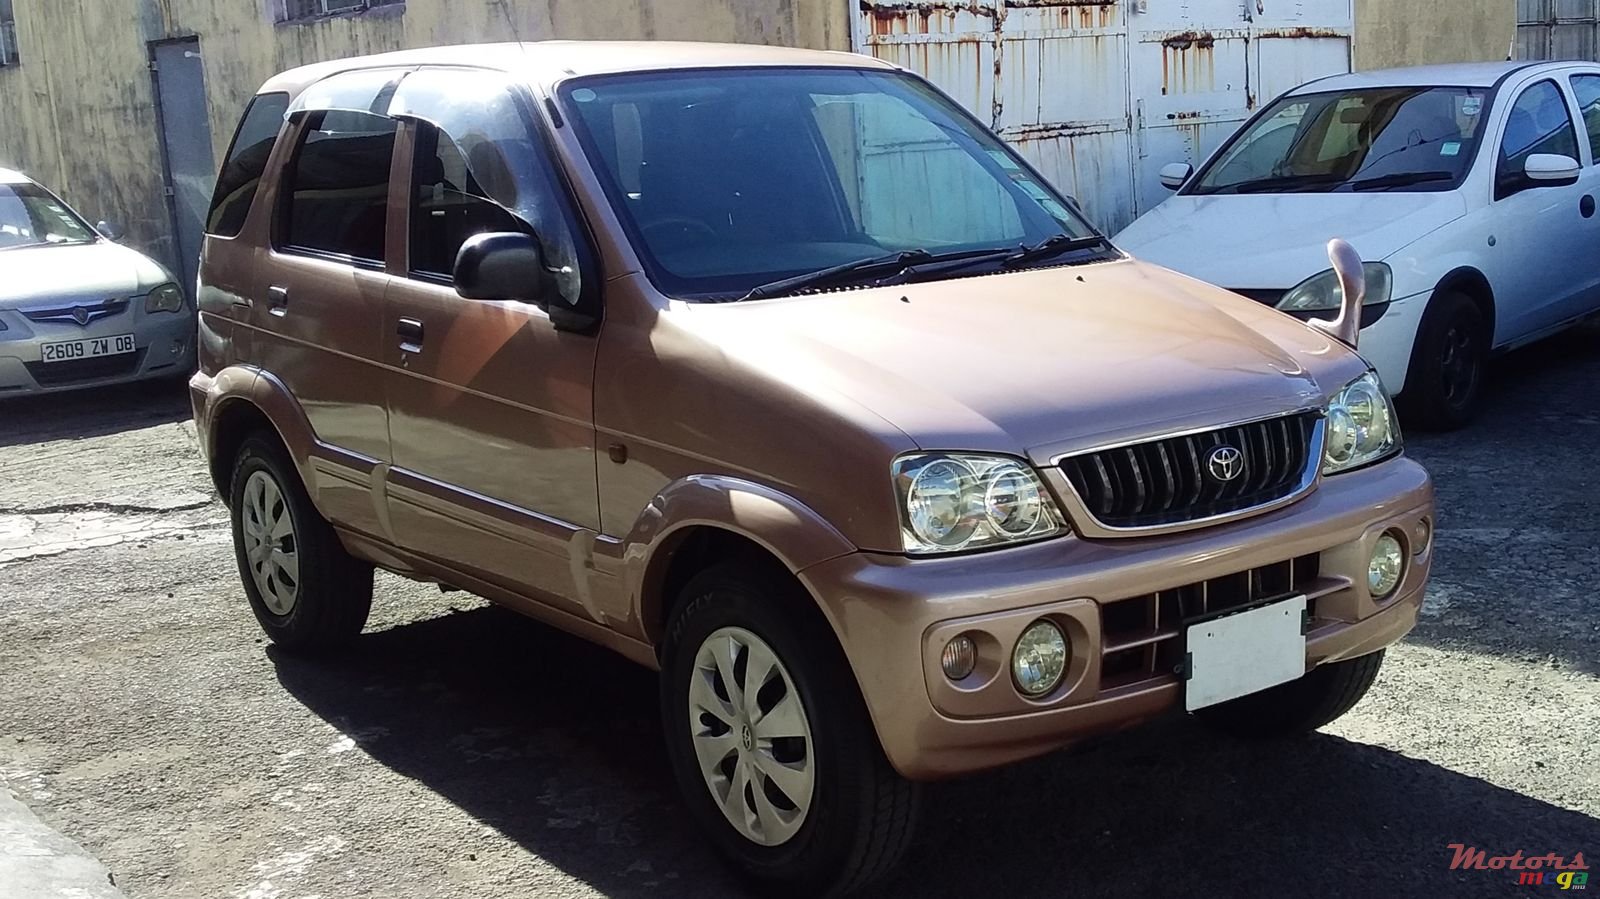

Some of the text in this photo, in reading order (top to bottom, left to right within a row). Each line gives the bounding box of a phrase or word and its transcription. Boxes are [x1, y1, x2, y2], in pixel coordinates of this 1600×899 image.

[46, 337, 132, 360] 2609 ZW 08
